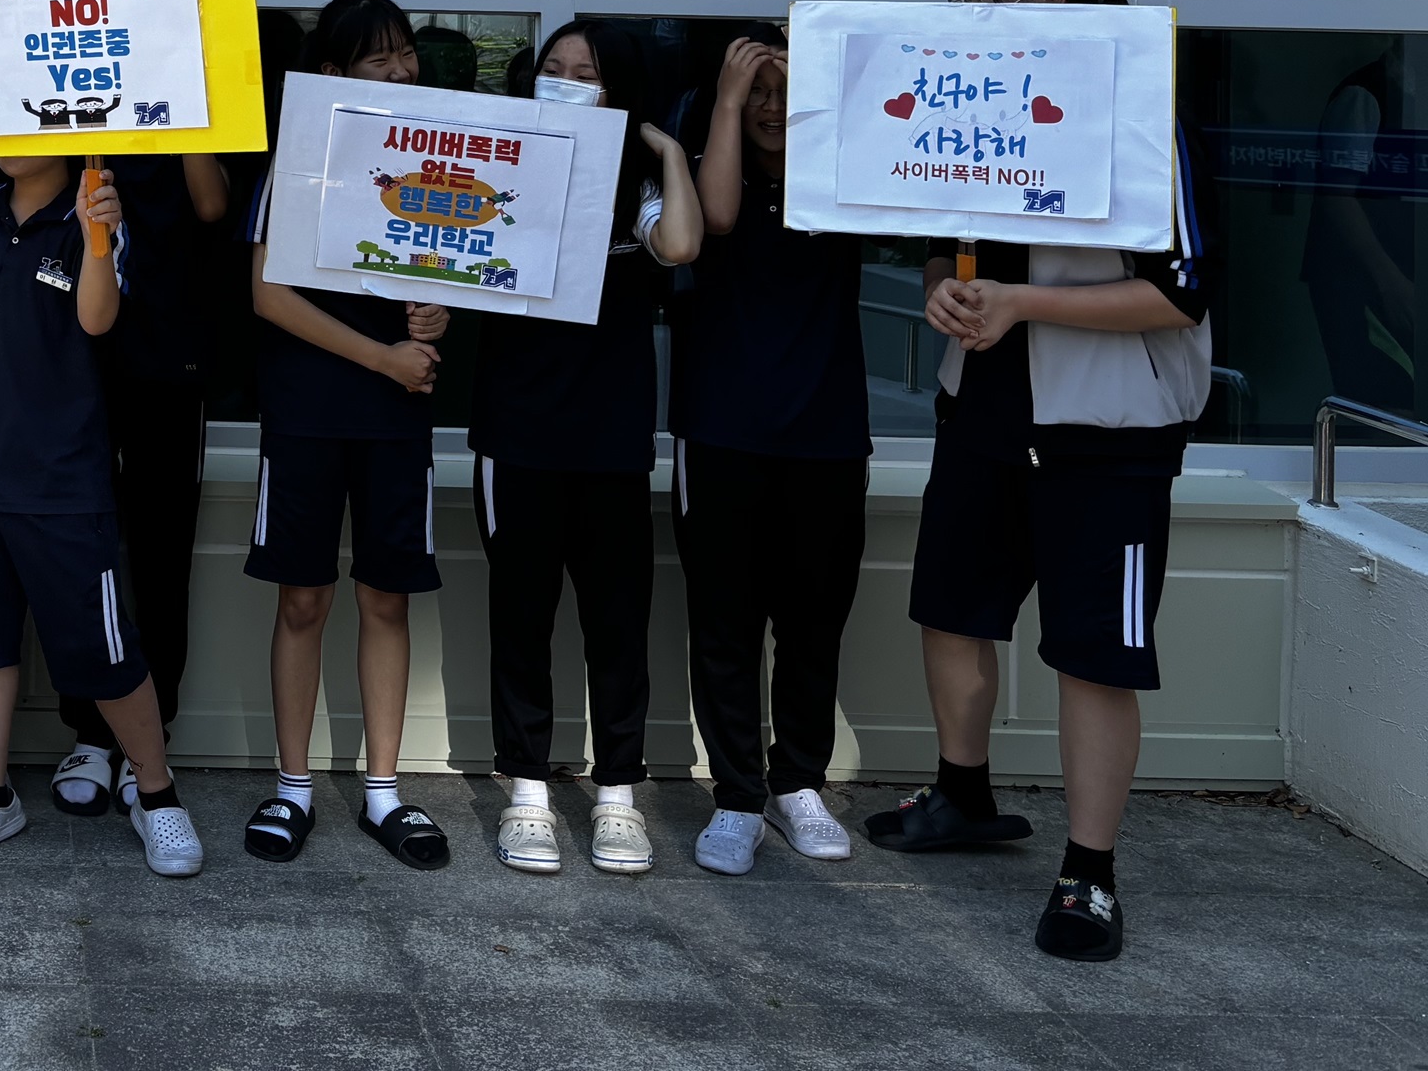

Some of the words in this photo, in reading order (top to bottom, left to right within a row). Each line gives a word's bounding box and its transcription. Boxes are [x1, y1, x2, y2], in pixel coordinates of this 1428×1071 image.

[24, 28, 131, 61] 인권존중
[47, 61, 122, 92] Yes!
[383, 125, 522, 165] 사이버폭력
[913, 126, 1027, 163] 사랑해
[419, 159, 476, 190] 없는
[890, 160, 990, 186] 사이버폭력
[997, 167, 1045, 188] NO!!
[398, 184, 484, 221] 행복한
[384, 218, 495, 257] 우리학교
[65, 754, 92, 766] NIKE
[1057, 877, 1080, 886] TOY
